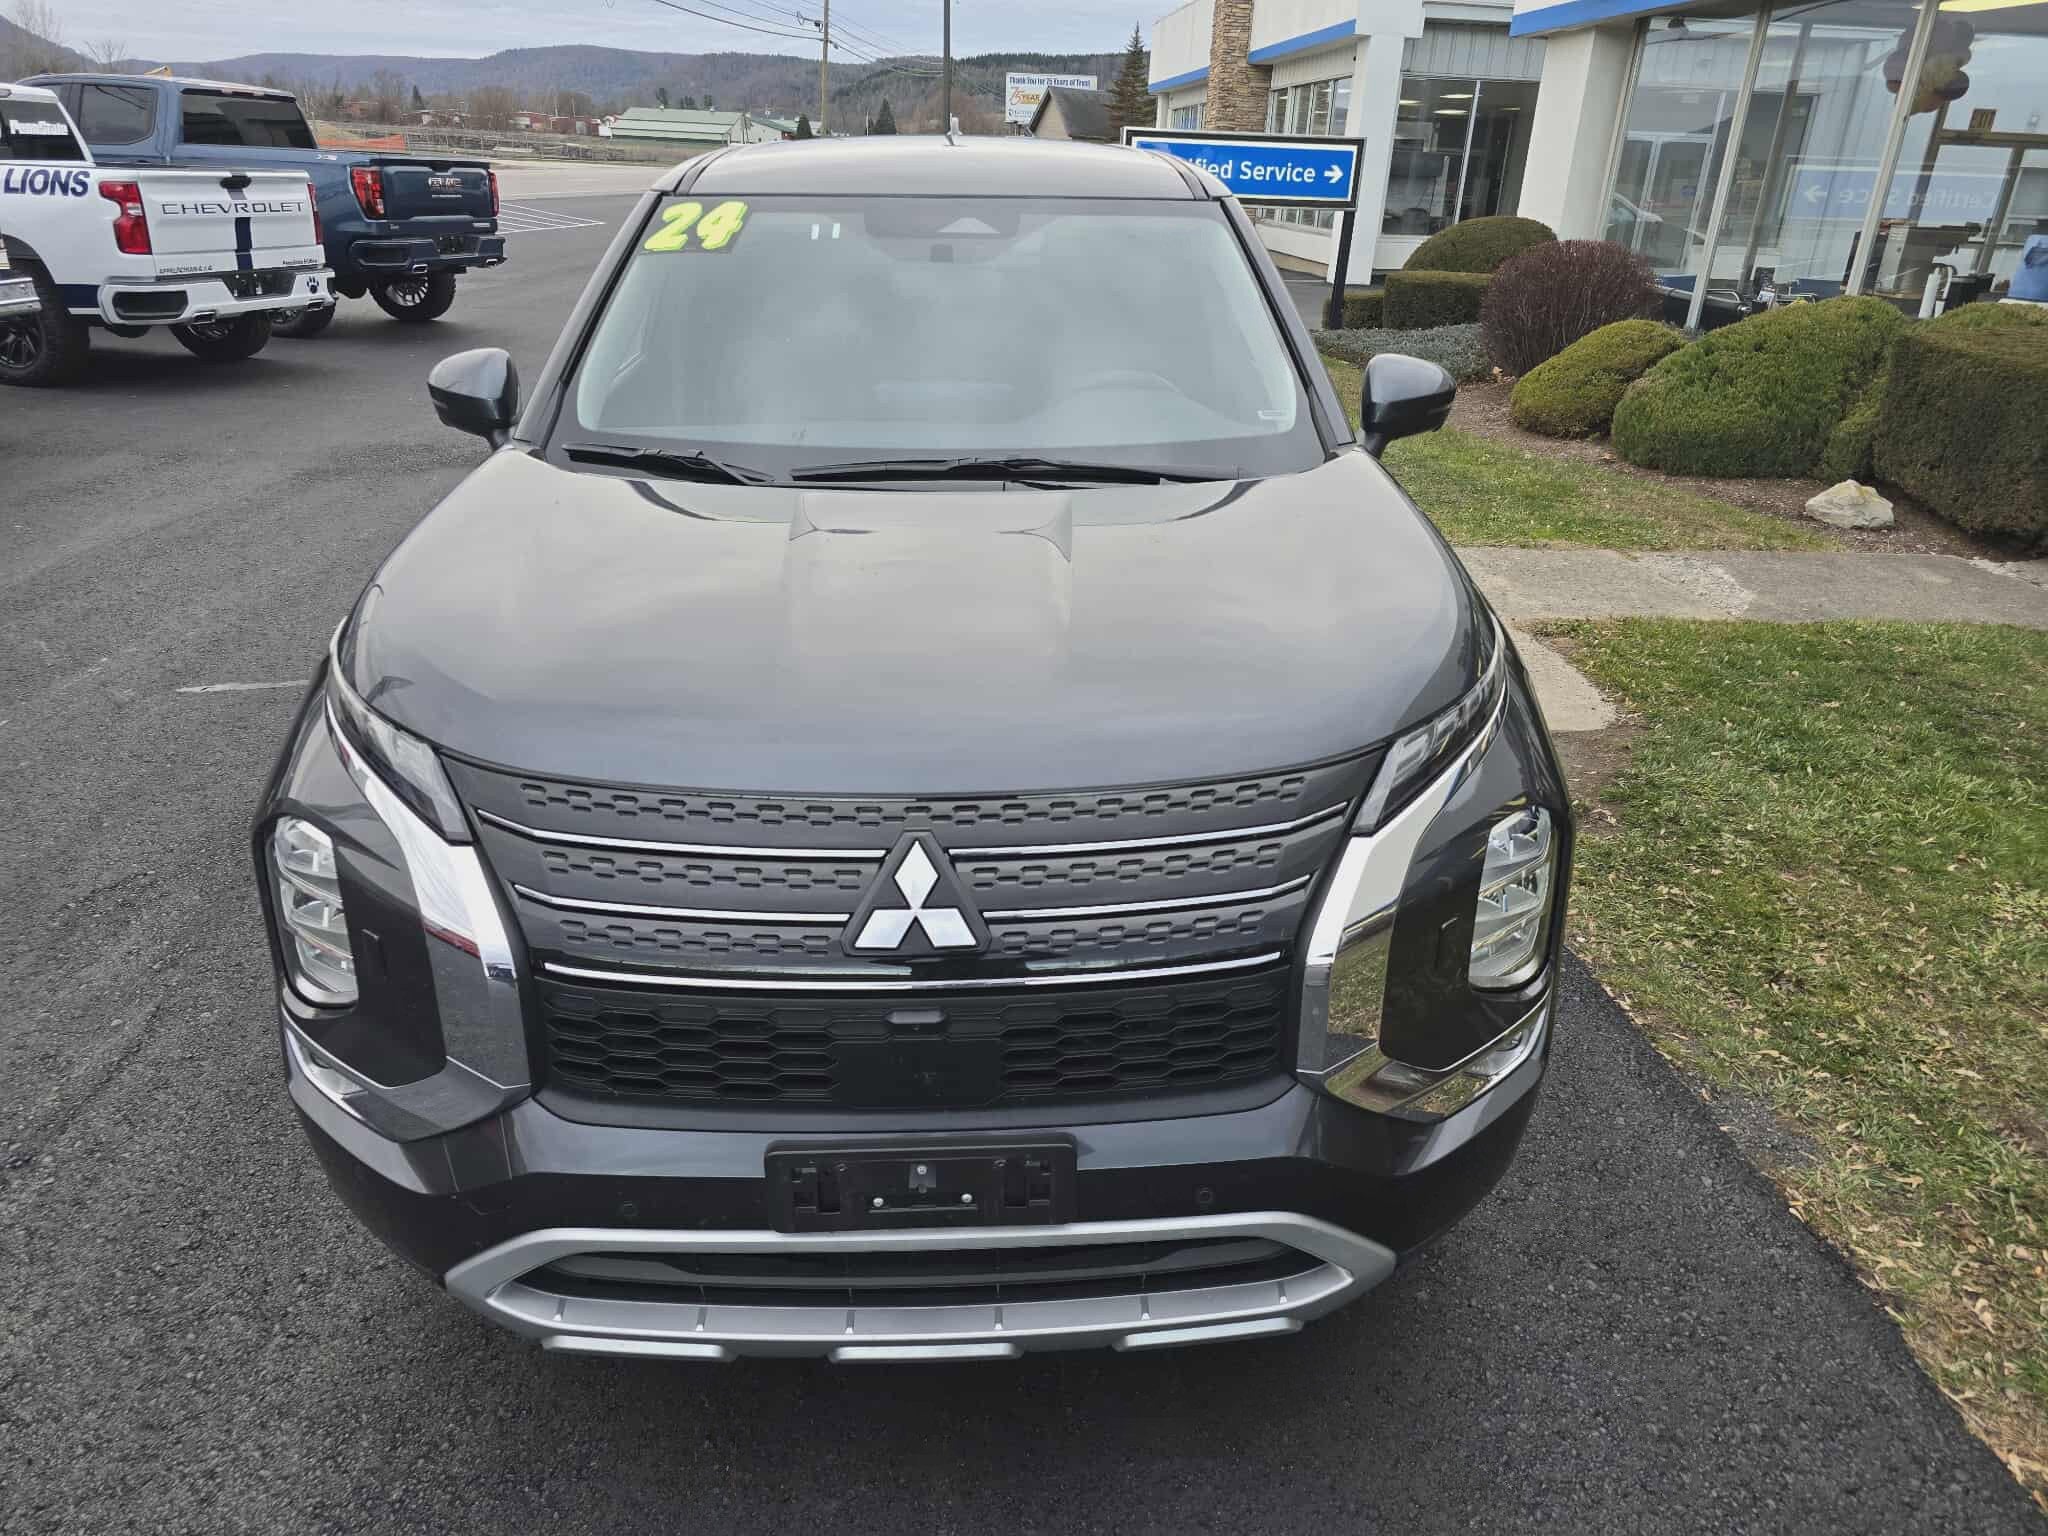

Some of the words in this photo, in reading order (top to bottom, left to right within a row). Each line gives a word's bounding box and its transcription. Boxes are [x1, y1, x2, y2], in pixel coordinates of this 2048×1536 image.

[1009, 76, 1025, 85] Thank
[4, 168, 90, 197] LIONS
[1239, 160, 1316, 183] Service
[161, 202, 305, 215] CHEVROLET
[644, 202, 748, 251] 24
